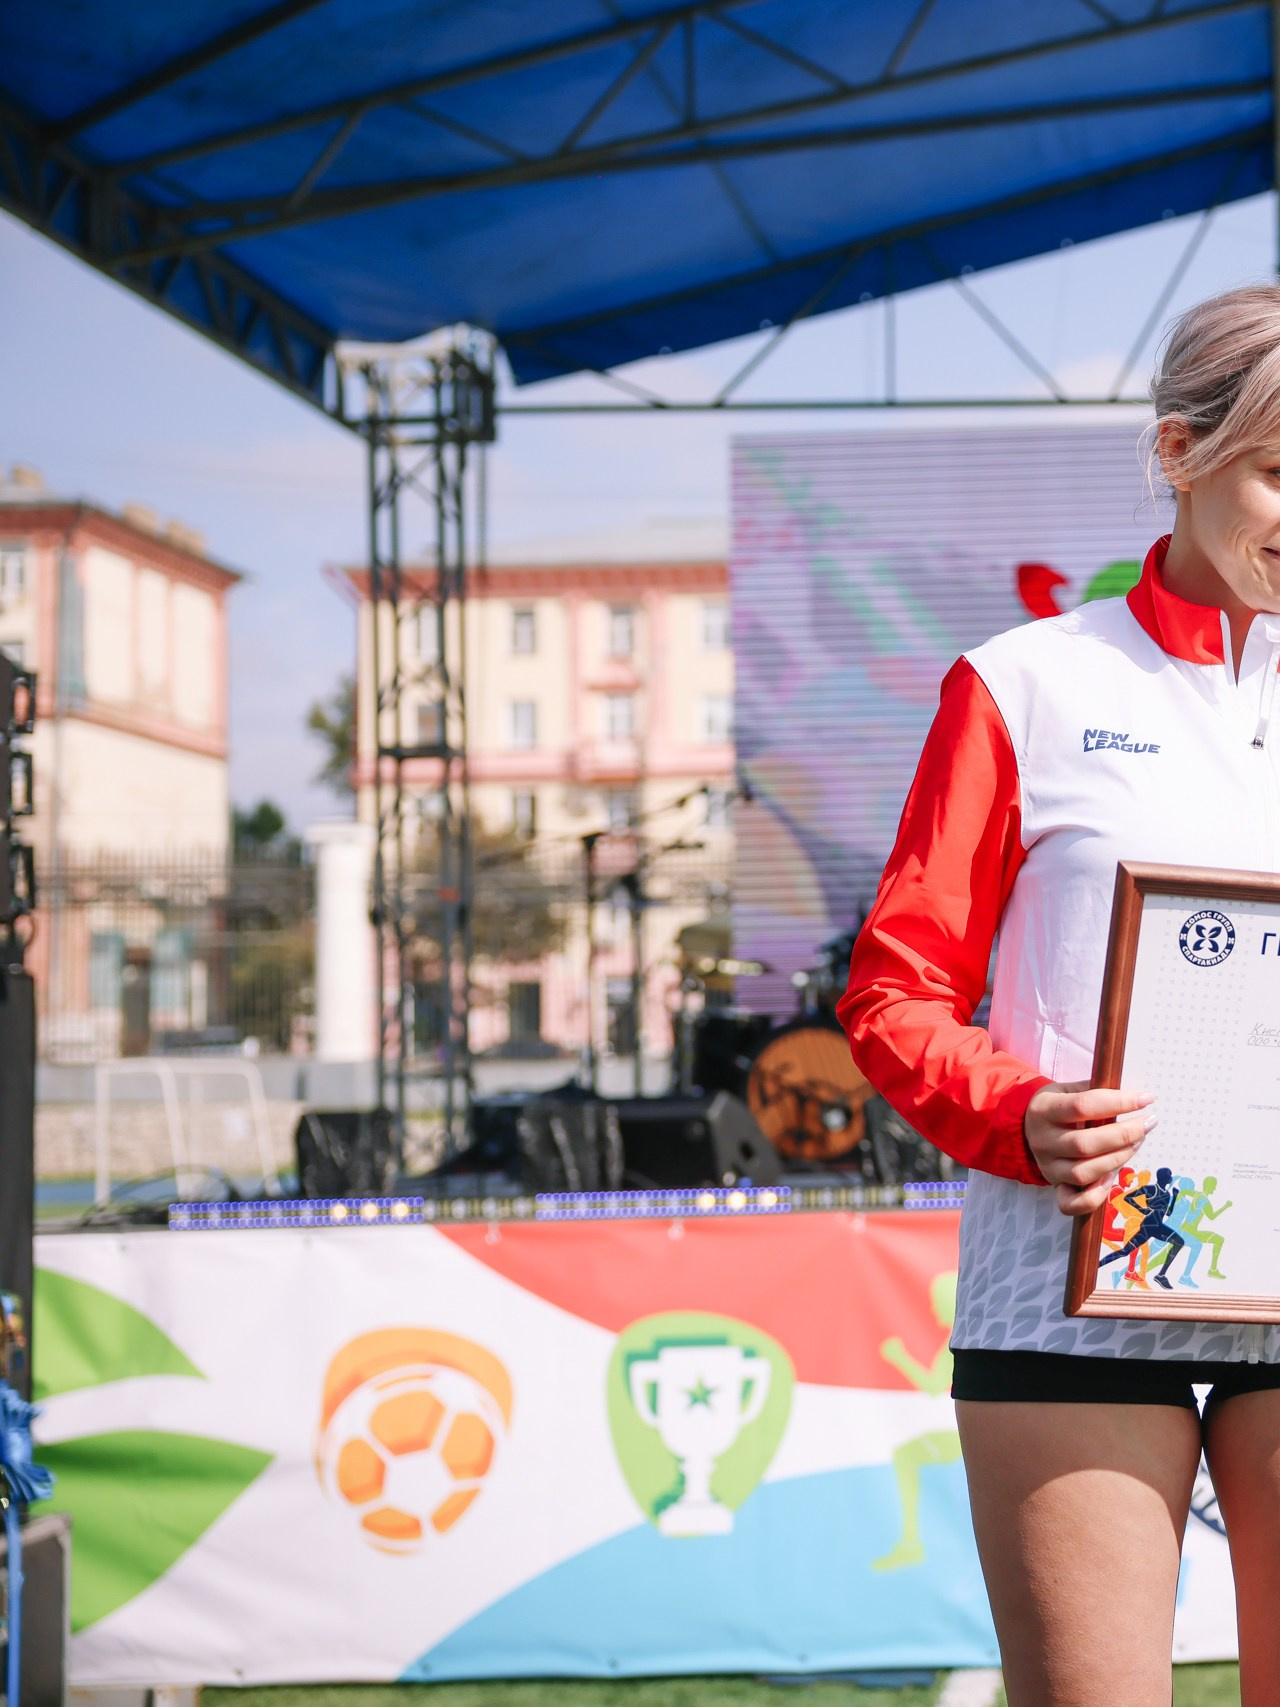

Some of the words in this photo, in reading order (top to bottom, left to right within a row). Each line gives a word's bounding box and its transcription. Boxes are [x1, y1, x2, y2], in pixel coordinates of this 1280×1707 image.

[1083, 729, 1129, 744] NEW
[1083, 739, 1161, 753] LEAGUE
[1186, 911, 1212, 929] КОМОС
[1212, 911, 1233, 932] ГРУПП
[1181, 945, 1231, 967] СПАРТАКИАДА
